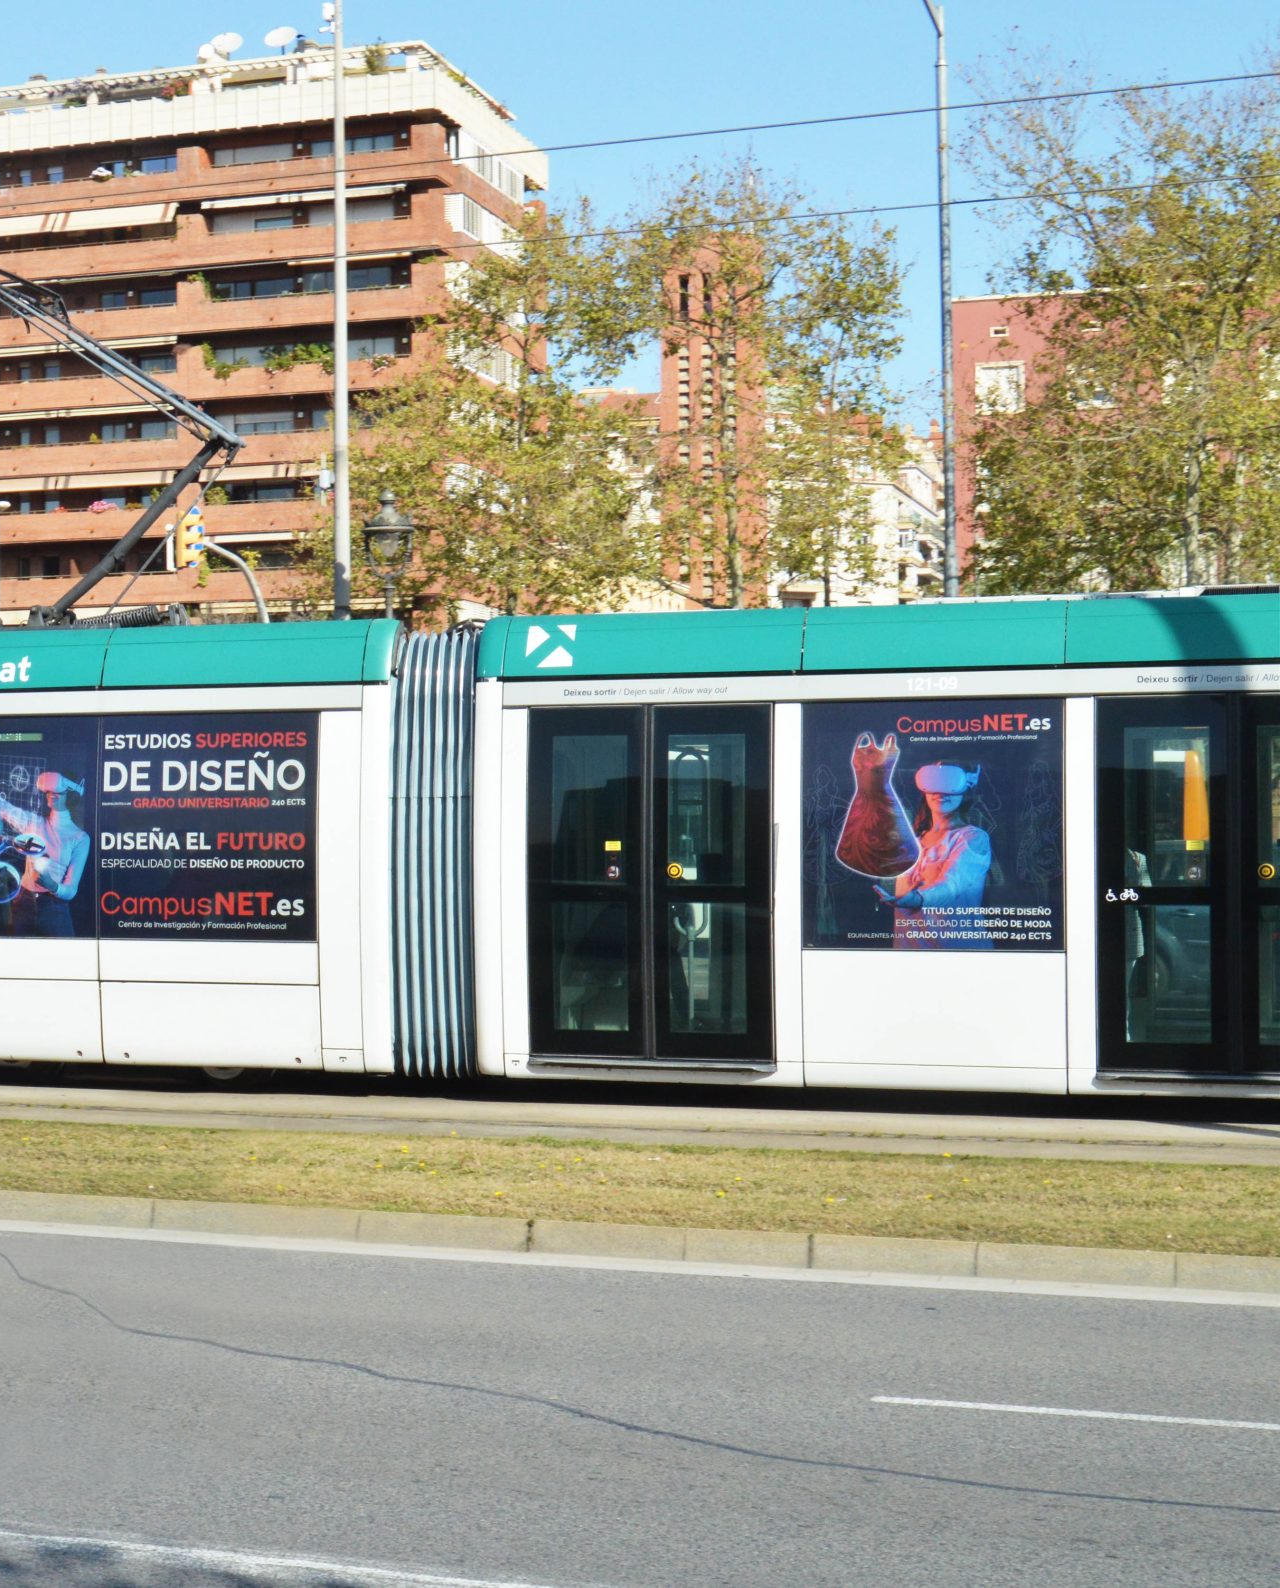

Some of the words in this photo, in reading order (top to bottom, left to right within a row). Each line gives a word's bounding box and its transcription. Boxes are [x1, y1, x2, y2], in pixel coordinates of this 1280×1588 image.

[906, 676, 958, 691] 121-09
[1137, 675, 1169, 683] Deixeu
[1172, 675, 1199, 683] sortir
[1206, 674, 1233, 684] Dejen
[1235, 674, 1253, 682] salir
[1262, 673, 1280, 681] Allo
[563, 688, 592, 696] Deixeu
[594, 688, 616, 696] sortir
[623, 687, 647, 697] Dejen
[649, 687, 665, 695] salir
[672, 686, 694, 695] Allow
[696, 687, 712, 695] way
[714, 686, 728, 694] out
[896, 713, 1051, 736] CampusNET.es
[104, 733, 191, 750] ESTUDIOS
[195, 732, 308, 748] SUPERIORES
[103, 760, 151, 792] DE
[162, 751, 306, 792] DISEÑO
[133, 797, 175, 809] GRADO
[178, 797, 270, 809] UNIVERSITARIO
[271, 799, 286, 807] 240
[286, 798, 306, 806] ECTS
[101, 827, 180, 850] DISEÑA
[186, 832, 211, 850] EL
[216, 832, 306, 850] FUTURO
[101, 858, 171, 868] ESPECIALIDAD
[173, 859, 188, 868] DE
[189, 857, 228, 869] DISEÑO
[230, 859, 244, 869] DE
[246, 859, 305, 869] PRODUCTO
[101, 891, 305, 920] CampusNET.es
[956, 907, 1001, 916] SUPERIOR
[1003, 907, 1015, 916] DE
[1017, 906, 1052, 916] DISEÑO
[118, 920, 142, 929] Centro
[143, 921, 153, 929] de
[154, 921, 200, 931] Investigación
[201, 923, 207, 931] y
[207, 921, 245, 930] Formación
[246, 921, 287, 930] Profesional
[895, 919, 958, 928] ESPECIALIDAD
[960, 919, 972, 928] DE
[974, 918, 1009, 928] DISEÑO
[1010, 919, 1022, 928] DE
[1024, 920, 1052, 928] MODA
[906, 931, 938, 940] GRADO
[940, 931, 1009, 940] UNIVERSITARIO
[1010, 931, 1027, 940] 240
[1028, 931, 1052, 941] ECTS
